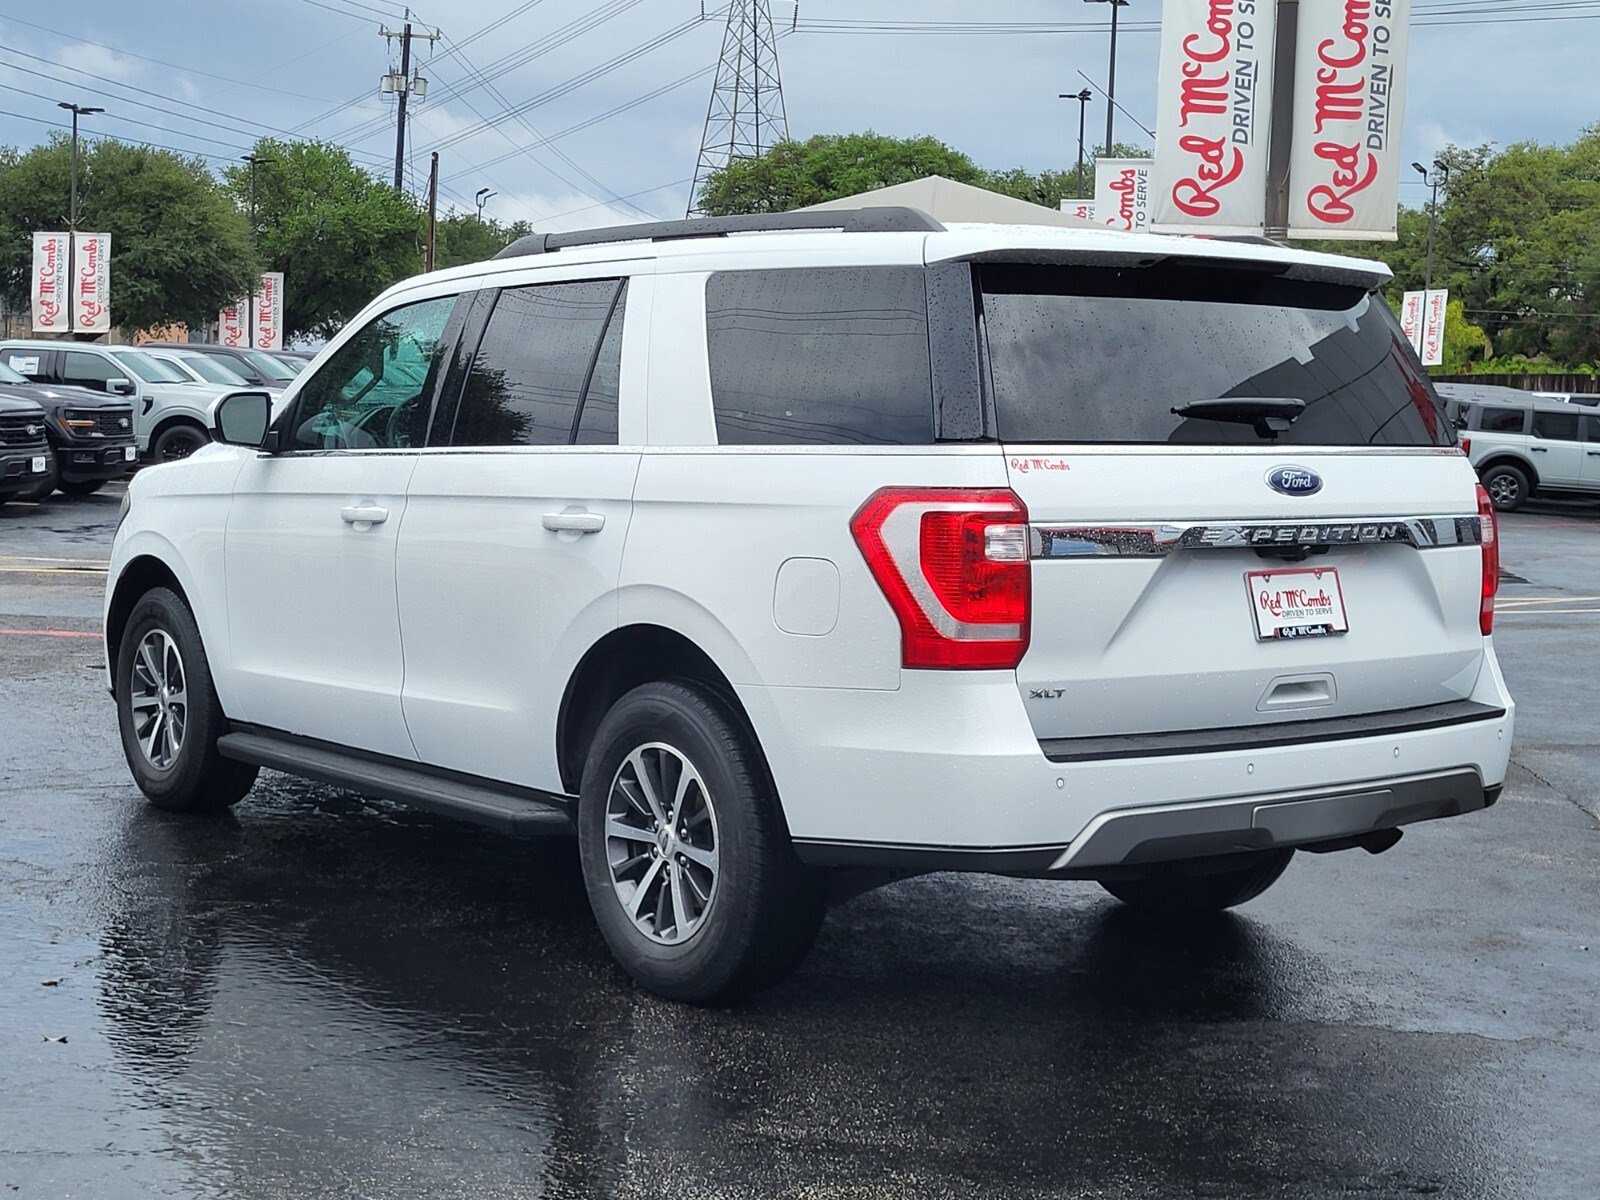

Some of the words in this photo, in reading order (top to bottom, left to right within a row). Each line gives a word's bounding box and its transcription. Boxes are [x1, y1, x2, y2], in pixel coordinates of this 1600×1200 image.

[1236, 22, 1254, 52] TO
[1372, 26, 1390, 57] TO
[1178, 0, 1234, 128] McCom
[1314, 0, 1371, 134] McCom
[1232, 59, 1253, 145] DRIVEN
[1366, 64, 1388, 150] DRIVEN
[1136, 169, 1148, 208] SERVE
[1172, 135, 1244, 217] Red
[1307, 142, 1378, 223] Red
[1136, 211, 1146, 228] TO
[40, 239, 56, 298] McCombs
[57, 264, 62, 273] TO
[81, 239, 97, 298] McCombs
[98, 264, 104, 273] TO
[39, 300, 60, 327] Red
[80, 300, 102, 327] Red
[224, 326, 242, 347] Red
[258, 327, 276, 348] Red
[1011, 458, 1029, 473] Red
[1029, 459, 1070, 470] McCombs
[1281, 470, 1313, 488] Ford
[1200, 525, 1398, 546] EXPEDITION
[1260, 590, 1282, 616] Red
[1282, 589, 1332, 608] McCombs
[1282, 610, 1304, 618] DRIVEN
[1315, 607, 1333, 615] SERVE
[1282, 627, 1296, 637] Red
[1297, 625, 1326, 636] McCombs
[1029, 688, 1066, 699] XLT
